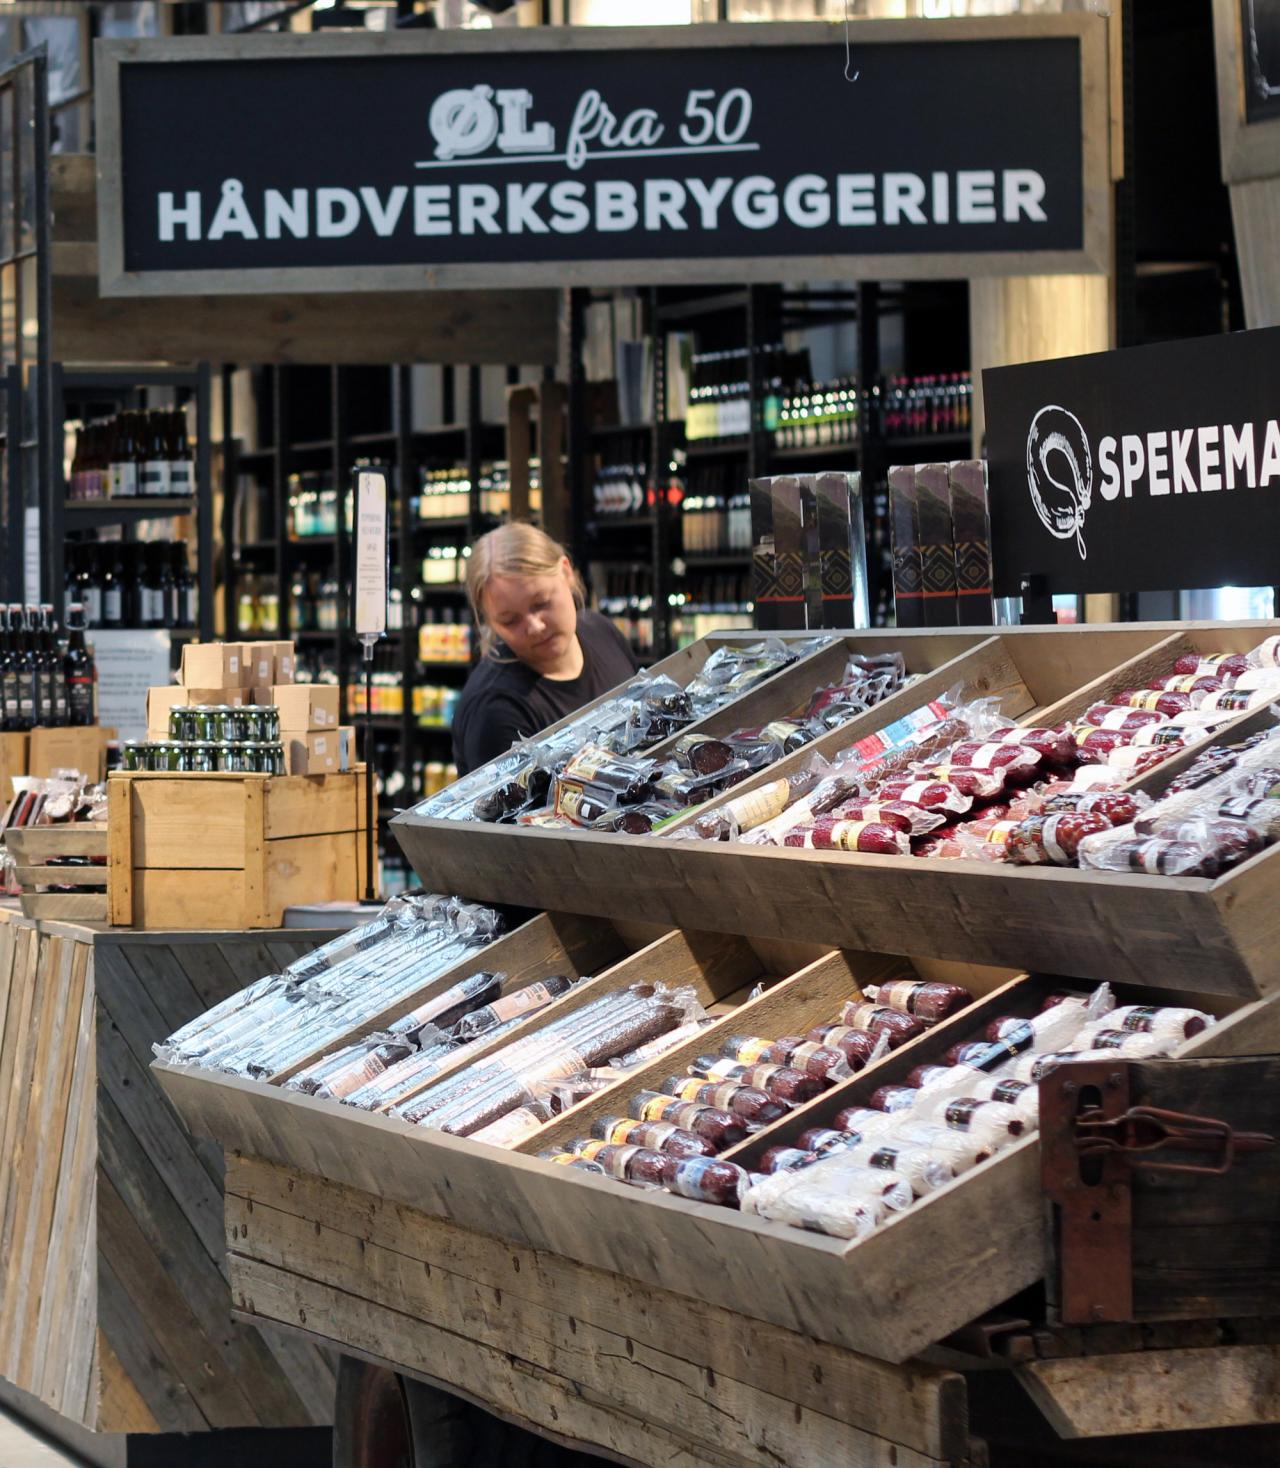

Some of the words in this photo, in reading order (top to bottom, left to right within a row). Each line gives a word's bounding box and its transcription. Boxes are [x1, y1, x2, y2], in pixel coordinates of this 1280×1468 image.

[429, 84, 555, 160] ØL
[566, 89, 665, 170] fra
[679, 88, 752, 144] 50
[157, 168, 1048, 241] HÅNDVERKSBRYGGERIER
[1098, 419, 1280, 501] SPEKEMA
